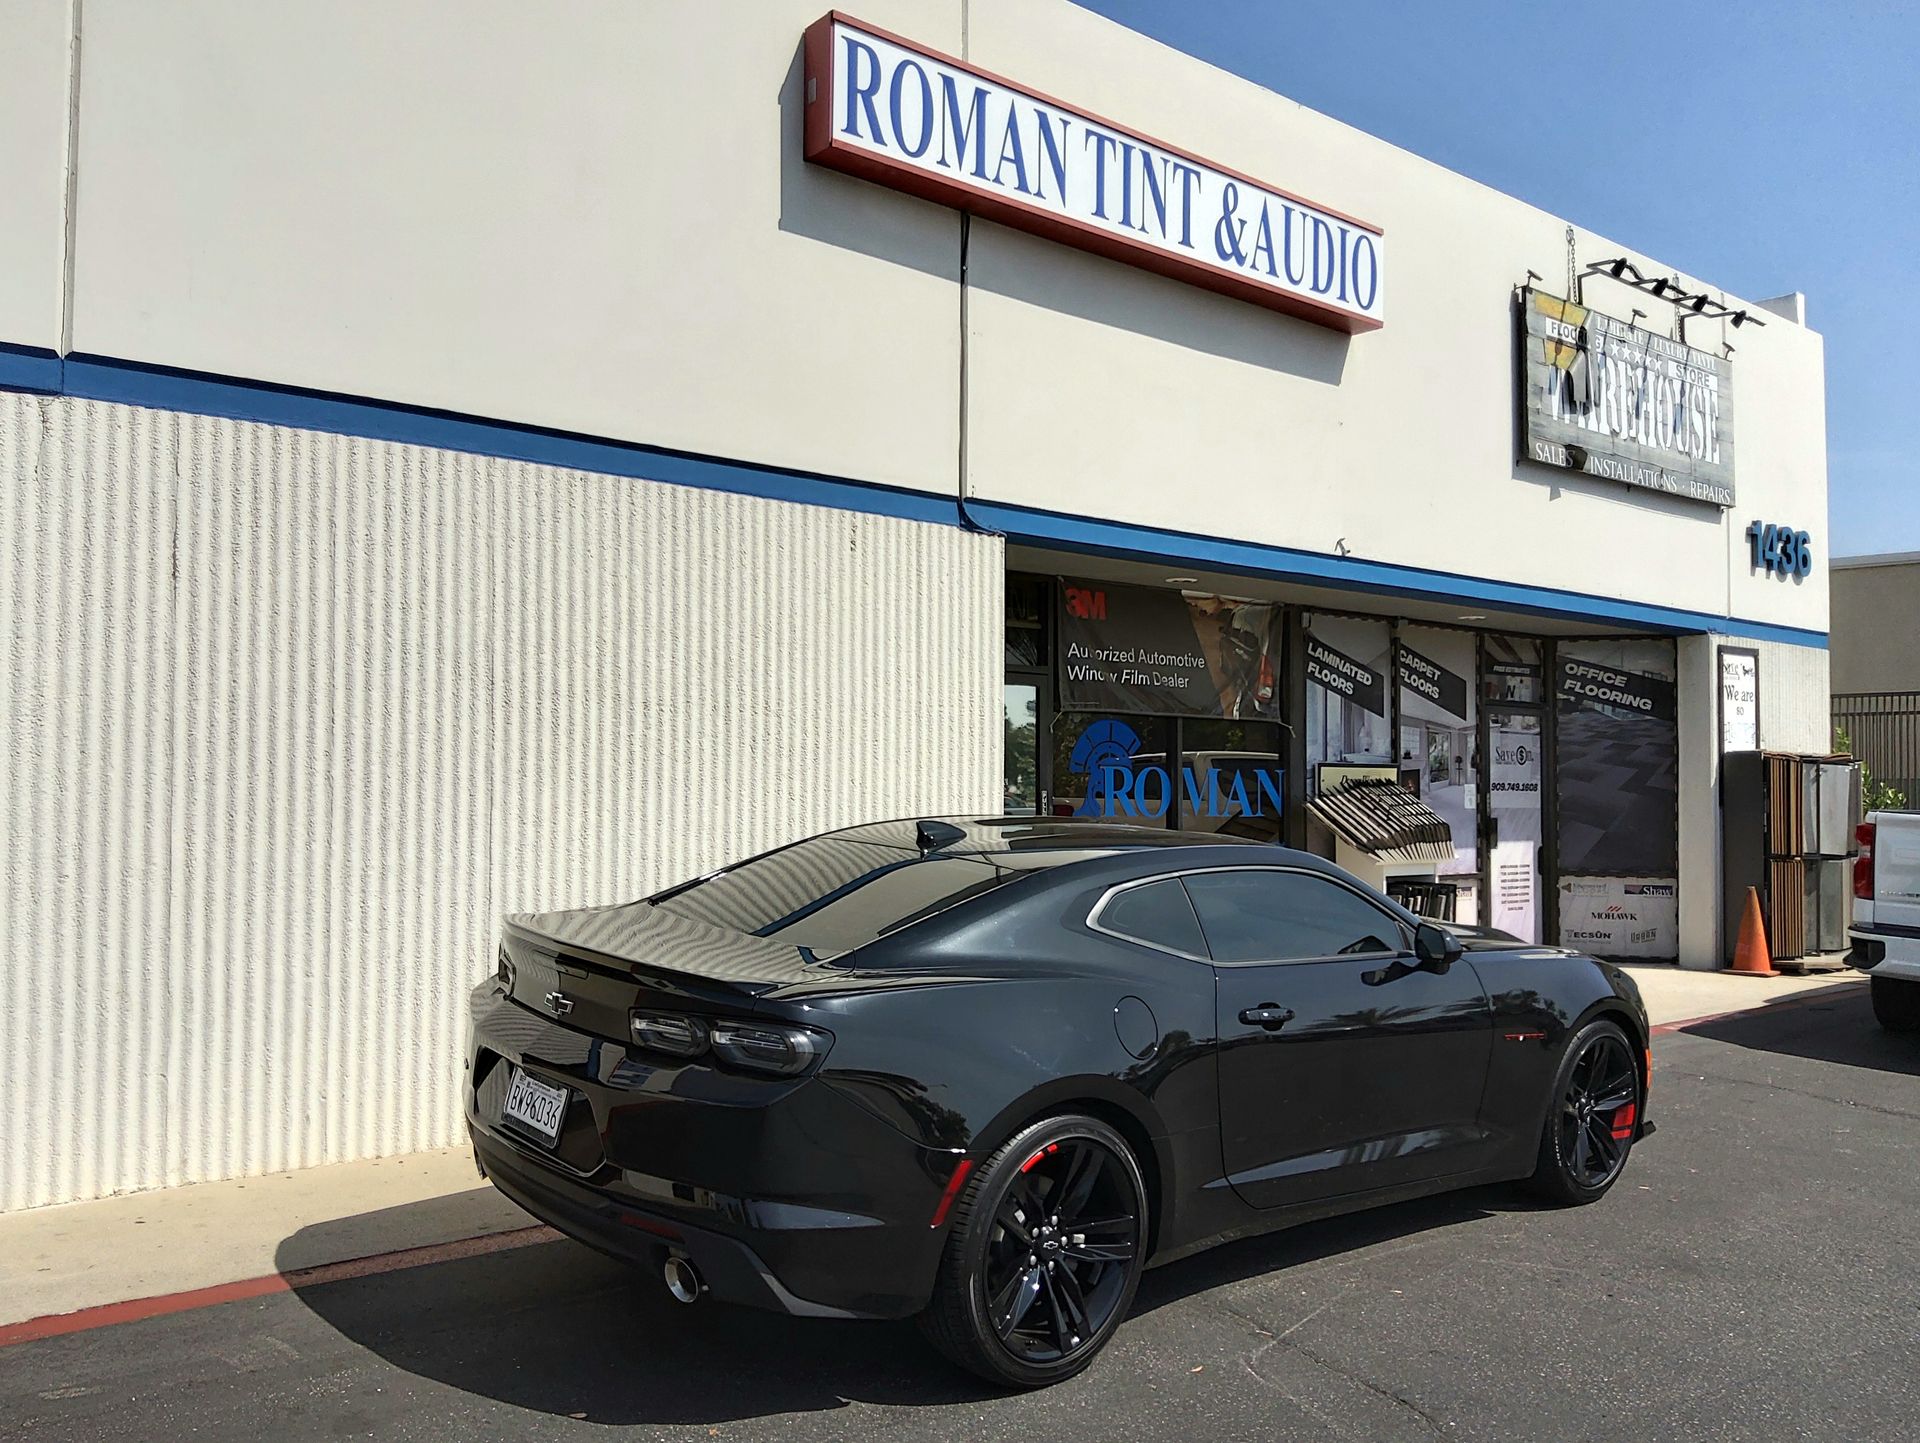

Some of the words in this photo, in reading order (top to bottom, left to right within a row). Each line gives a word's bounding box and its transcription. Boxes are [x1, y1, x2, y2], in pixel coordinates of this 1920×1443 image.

[841, 35, 1072, 208] ROMAN
[1085, 128, 1201, 249] TINT
[1676, 363, 1711, 387] STORE
[1535, 442, 1575, 468] SALES
[1589, 455, 1678, 493] INSTALLATIONS
[1689, 480, 1731, 505] REPAIRS
[1746, 520, 1812, 578] 1436
[1065, 587, 1108, 620] 3M
[1067, 642, 1135, 663] Auorized
[1138, 648, 1205, 668] Automotive
[1307, 642, 1373, 686] LAMINATED
[1400, 649, 1441, 681] CARPET
[1121, 669, 1150, 686] Film
[1153, 671, 1189, 688] Dealer
[1307, 661, 1354, 695] FLOORS
[1399, 667, 1440, 699] FLOORS
[1564, 662, 1628, 688] OFFICE
[1564, 679, 1653, 711] FLOORING
[1099, 765, 1286, 818] ROMAN
[1643, 886, 1673, 897] Shaw
[1591, 911, 1638, 921] MOHAWK
